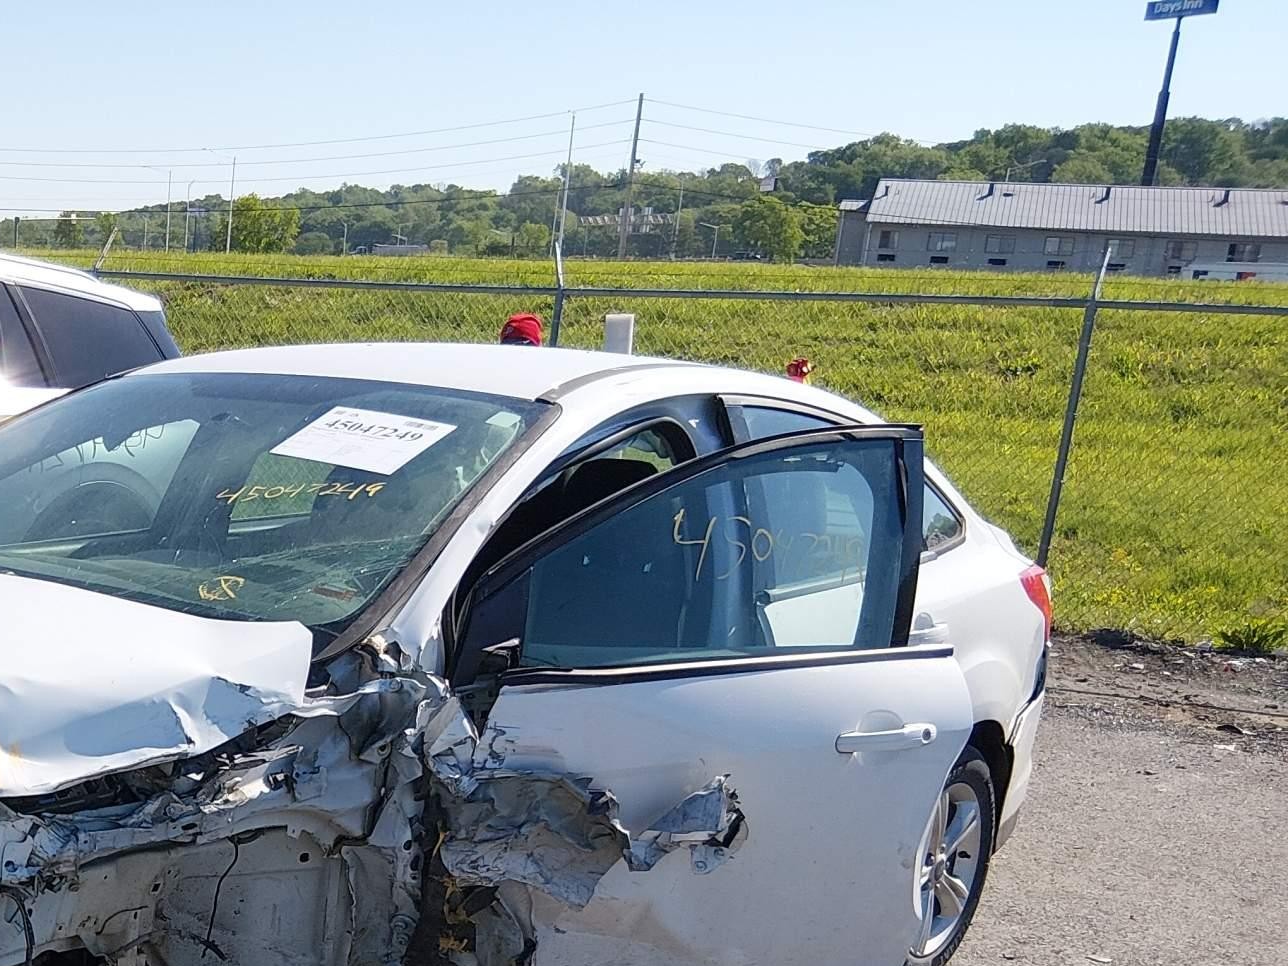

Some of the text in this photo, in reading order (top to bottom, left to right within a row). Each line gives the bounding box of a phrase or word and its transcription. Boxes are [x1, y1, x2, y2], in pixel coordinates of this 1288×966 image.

[1154, 0, 1202, 14] Days Inn
[324, 418, 424, 442] 45047249
[215, 481, 388, 504] 45047249
